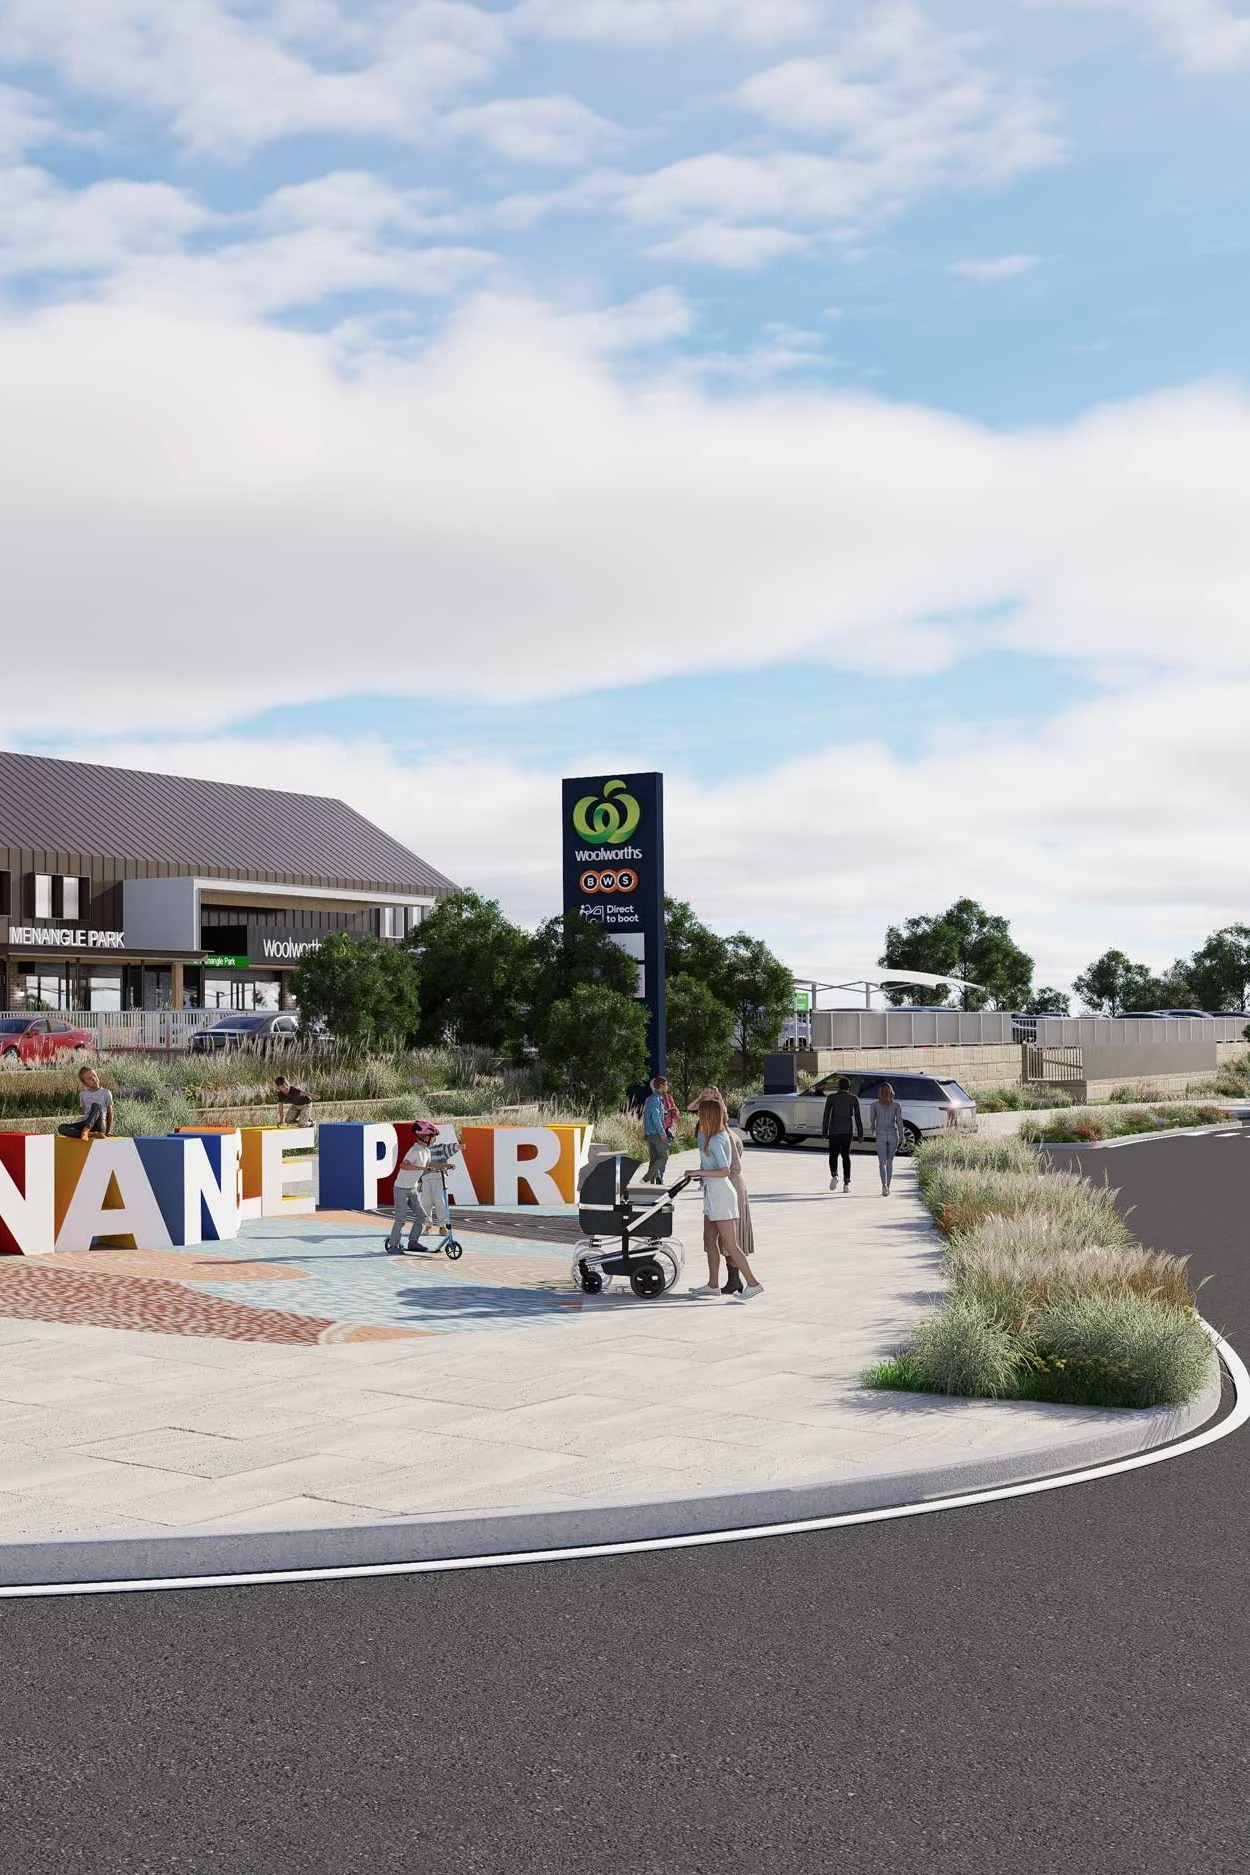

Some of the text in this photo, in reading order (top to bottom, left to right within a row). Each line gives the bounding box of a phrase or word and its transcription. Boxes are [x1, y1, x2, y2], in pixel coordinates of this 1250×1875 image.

[575, 846, 643, 861] Woolworths
[607, 905, 635, 913] Direct
[607, 914, 639, 923] to boot
[9, 926, 125, 949] MENANGLE PARK
[263, 936, 324, 958] Woolworth
[224, 957, 236, 966] Park
